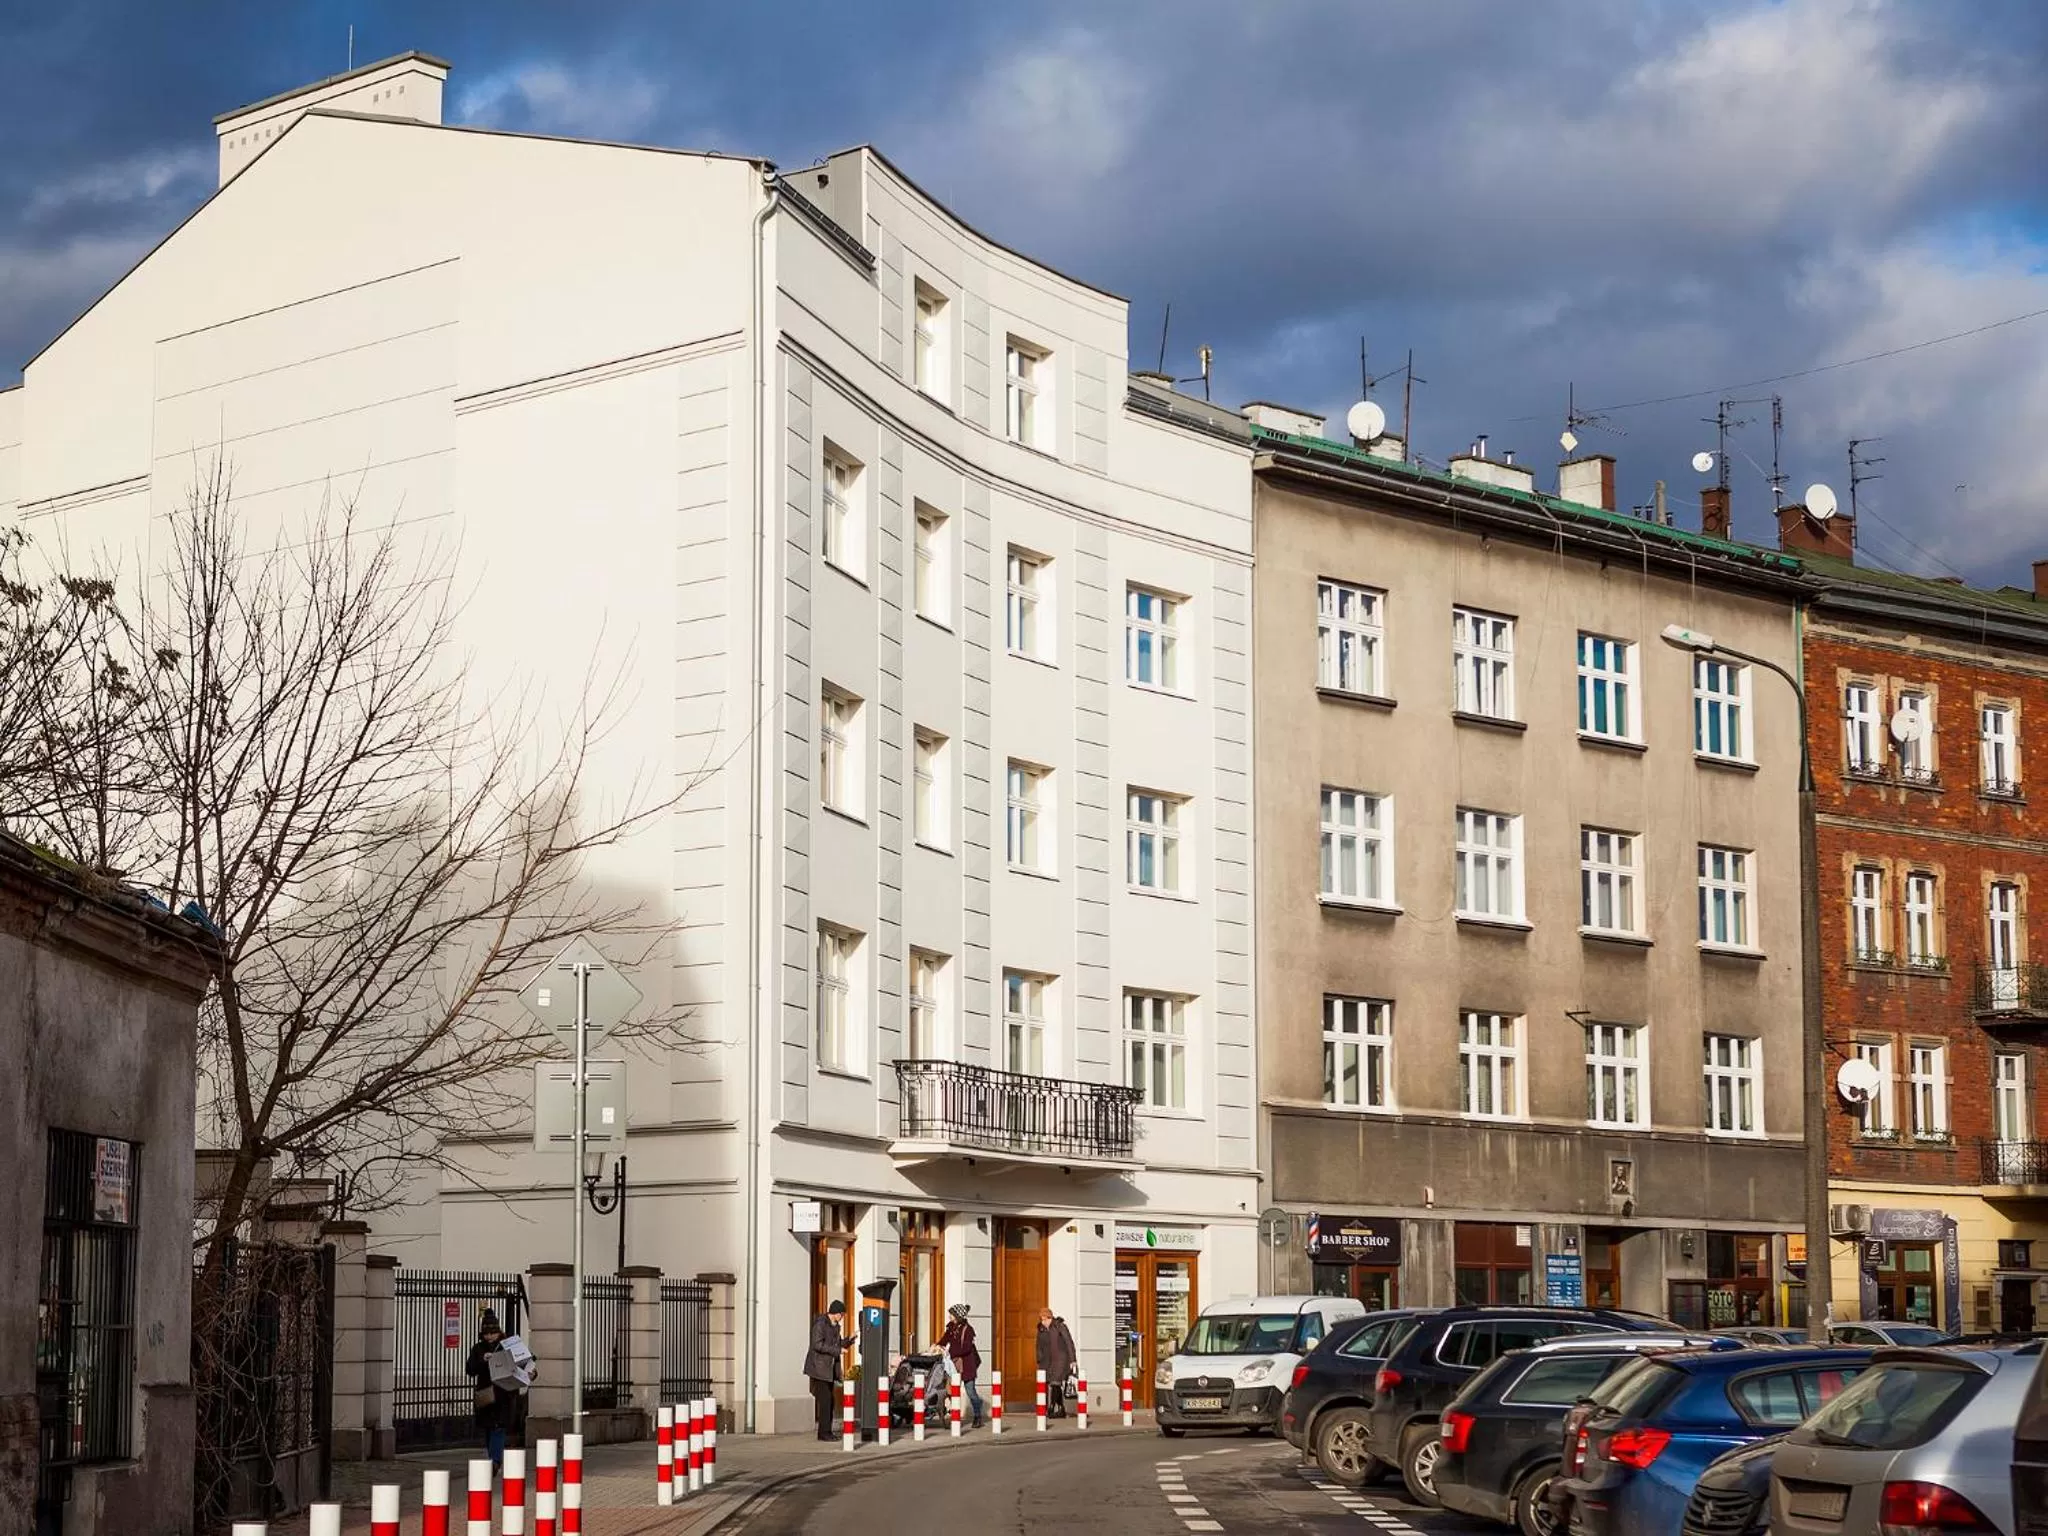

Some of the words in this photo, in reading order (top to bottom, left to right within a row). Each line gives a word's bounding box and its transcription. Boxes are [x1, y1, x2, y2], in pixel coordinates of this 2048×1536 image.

[1322, 1235, 1362, 1245] BARBER
[1363, 1236, 1390, 1246] SHOP
[1946, 1228, 1957, 1286] cukiernia
[1707, 1290, 1735, 1307] FOTO
[871, 1308, 880, 1322] P
